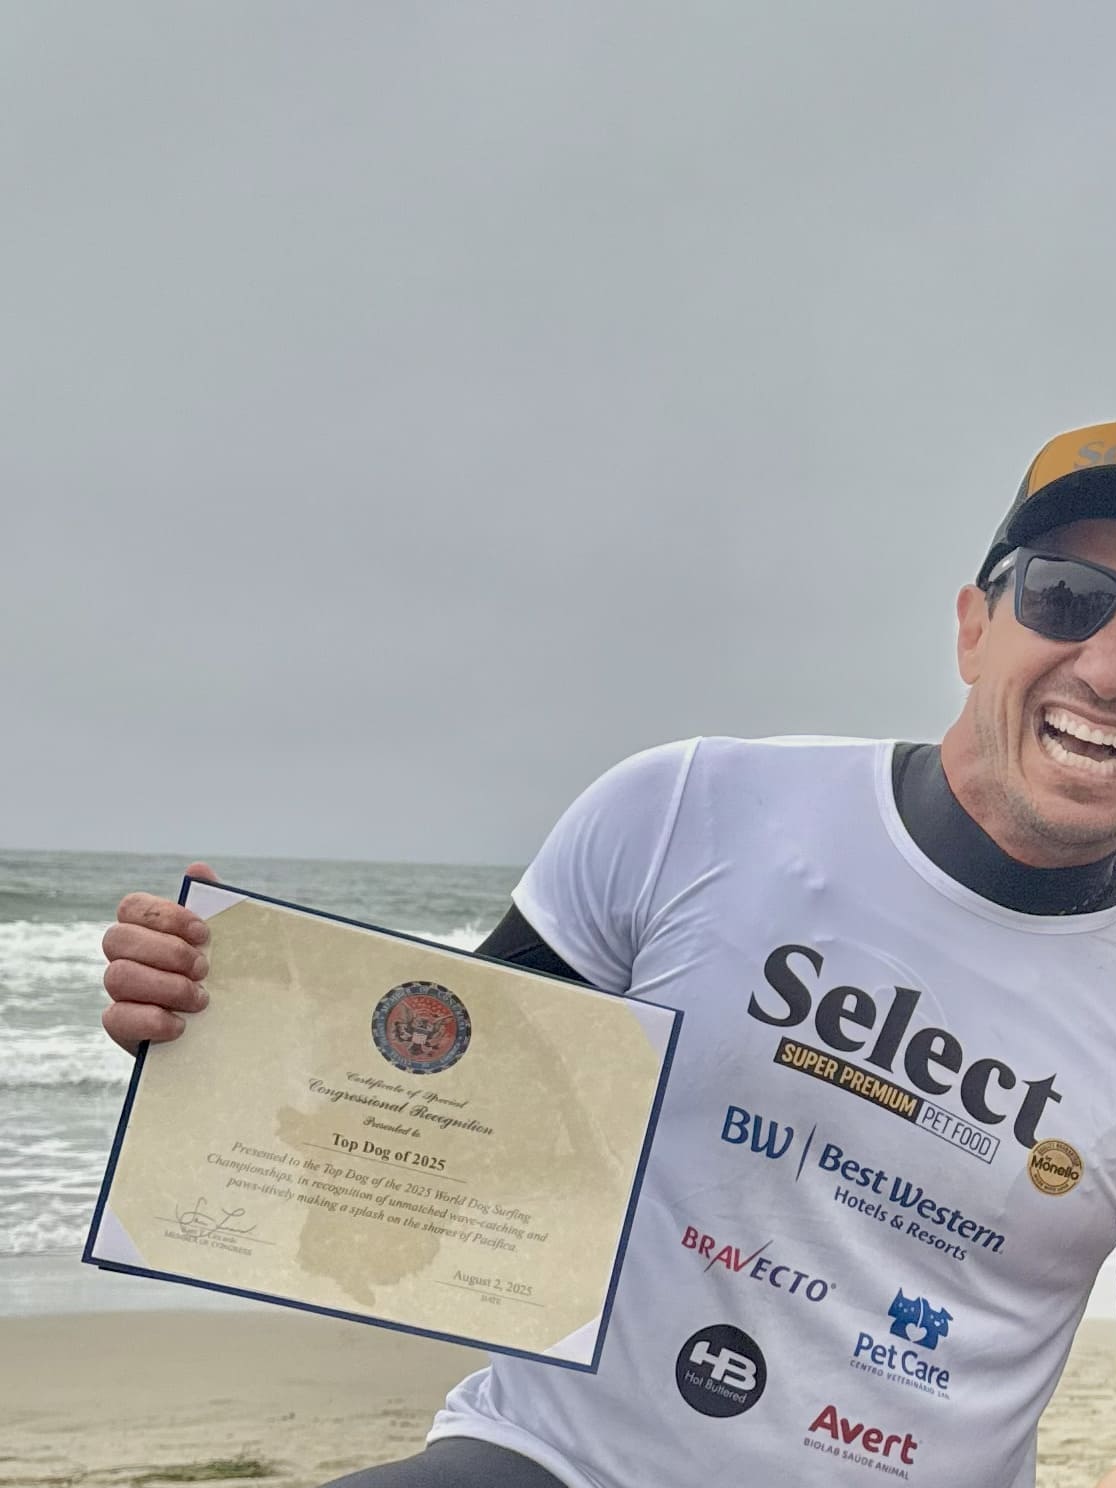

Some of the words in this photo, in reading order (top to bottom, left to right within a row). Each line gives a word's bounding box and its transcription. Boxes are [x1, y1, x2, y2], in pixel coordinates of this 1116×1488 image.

[747, 944, 1063, 1150] Select
[308, 1077, 409, 1114] Congressional
[410, 1104, 495, 1137] Recognition
[347, 1071, 404, 1093] Certificate
[406, 1089, 421, 1099] of
[781, 1043, 835, 1081] SUPER
[840, 1065, 919, 1118] PREMIUM
[332, 1132, 359, 1153] Top
[363, 1141, 391, 1162] Dog
[395, 1150, 414, 1162] of
[412, 1153, 447, 1172] 2025
[363, 1115, 414, 1137] Presented
[721, 1105, 794, 1160] BW
[921, 1106, 954, 1135] PET
[951, 1123, 992, 1158] FOOD
[226, 1176, 295, 1200] paws-itively
[296, 1193, 338, 1212] making
[339, 1203, 348, 1212] a
[348, 1204, 385, 1221] splash
[386, 1214, 401, 1224] on
[402, 1216, 420, 1230] the
[421, 1221, 458, 1239] shores
[459, 1229, 474, 1243] of
[231, 1141, 289, 1165] Presented
[289, 1156, 300, 1167] to
[303, 1159, 320, 1172] the
[323, 1162, 343, 1179] Top
[345, 1168, 370, 1185] Dog
[371, 1176, 386, 1188] of
[385, 1178, 402, 1192] the
[404, 1183, 432, 1199] 2025
[434, 1189, 466, 1207] World
[467, 1198, 491, 1215] Dog
[492, 1204, 532, 1225] Surfing
[297, 1175, 309, 1186] in
[311, 1180, 373, 1201] recognition
[375, 1193, 390, 1206] of
[388, 1198, 449, 1219] unmatched
[450, 1211, 526, 1239] wave-catching
[526, 1230, 549, 1243] and
[818, 1143, 889, 1195] Best
[889, 1176, 1006, 1254] Western
[833, 1185, 889, 1223] Hotels
[890, 1214, 905, 1230] &
[905, 1223, 968, 1263] Resorts
[453, 1269, 492, 1288] August
[505, 1280, 534, 1297] 2025
[684, 1370, 704, 1386] Hot
[704, 1378, 748, 1404] Buttered
[689, 1340, 757, 1391] HB
[849, 1359, 884, 1377] CENTRO
[853, 1331, 898, 1370] Pet
[901, 1350, 950, 1390] Care
[803, 1437, 841, 1456] BIOLAB
[875, 1461, 910, 1481] ANIMAL
[808, 1404, 919, 1465] Avert
